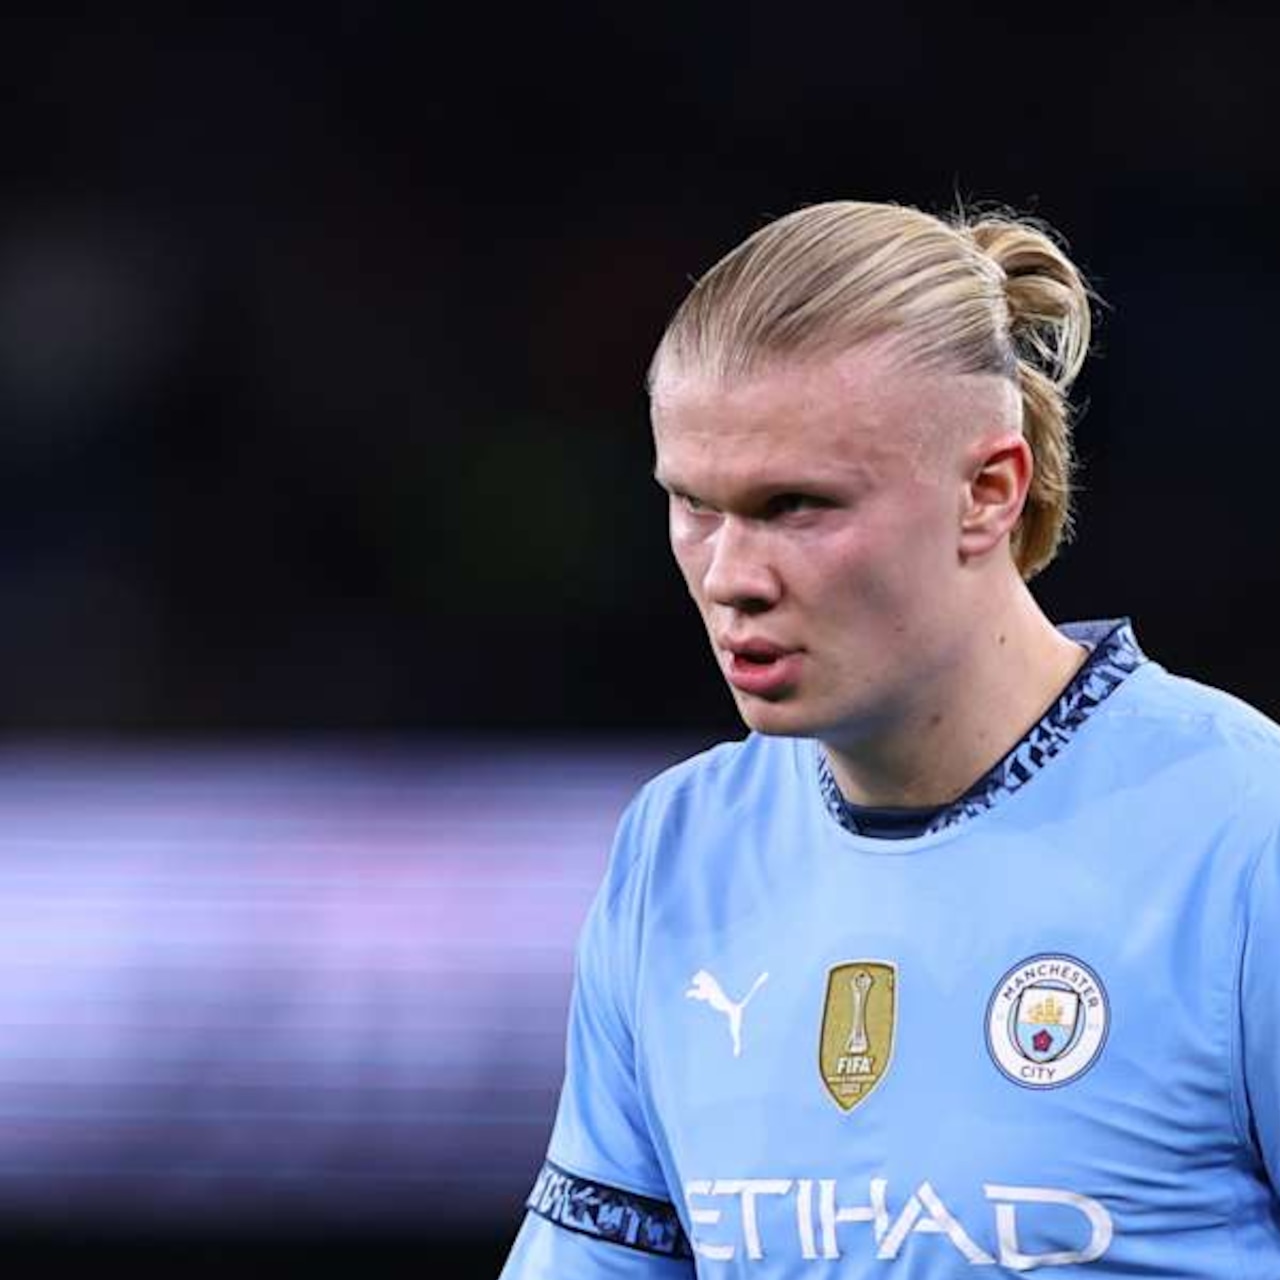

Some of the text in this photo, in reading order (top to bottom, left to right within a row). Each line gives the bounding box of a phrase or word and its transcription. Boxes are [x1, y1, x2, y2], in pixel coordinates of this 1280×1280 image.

[1002, 963, 1100, 1008] MANCHESTER
[837, 1056, 873, 1074] FIFA
[1020, 1065, 1057, 1080] CITY
[686, 1177, 1114, 1270] ETIHAD
